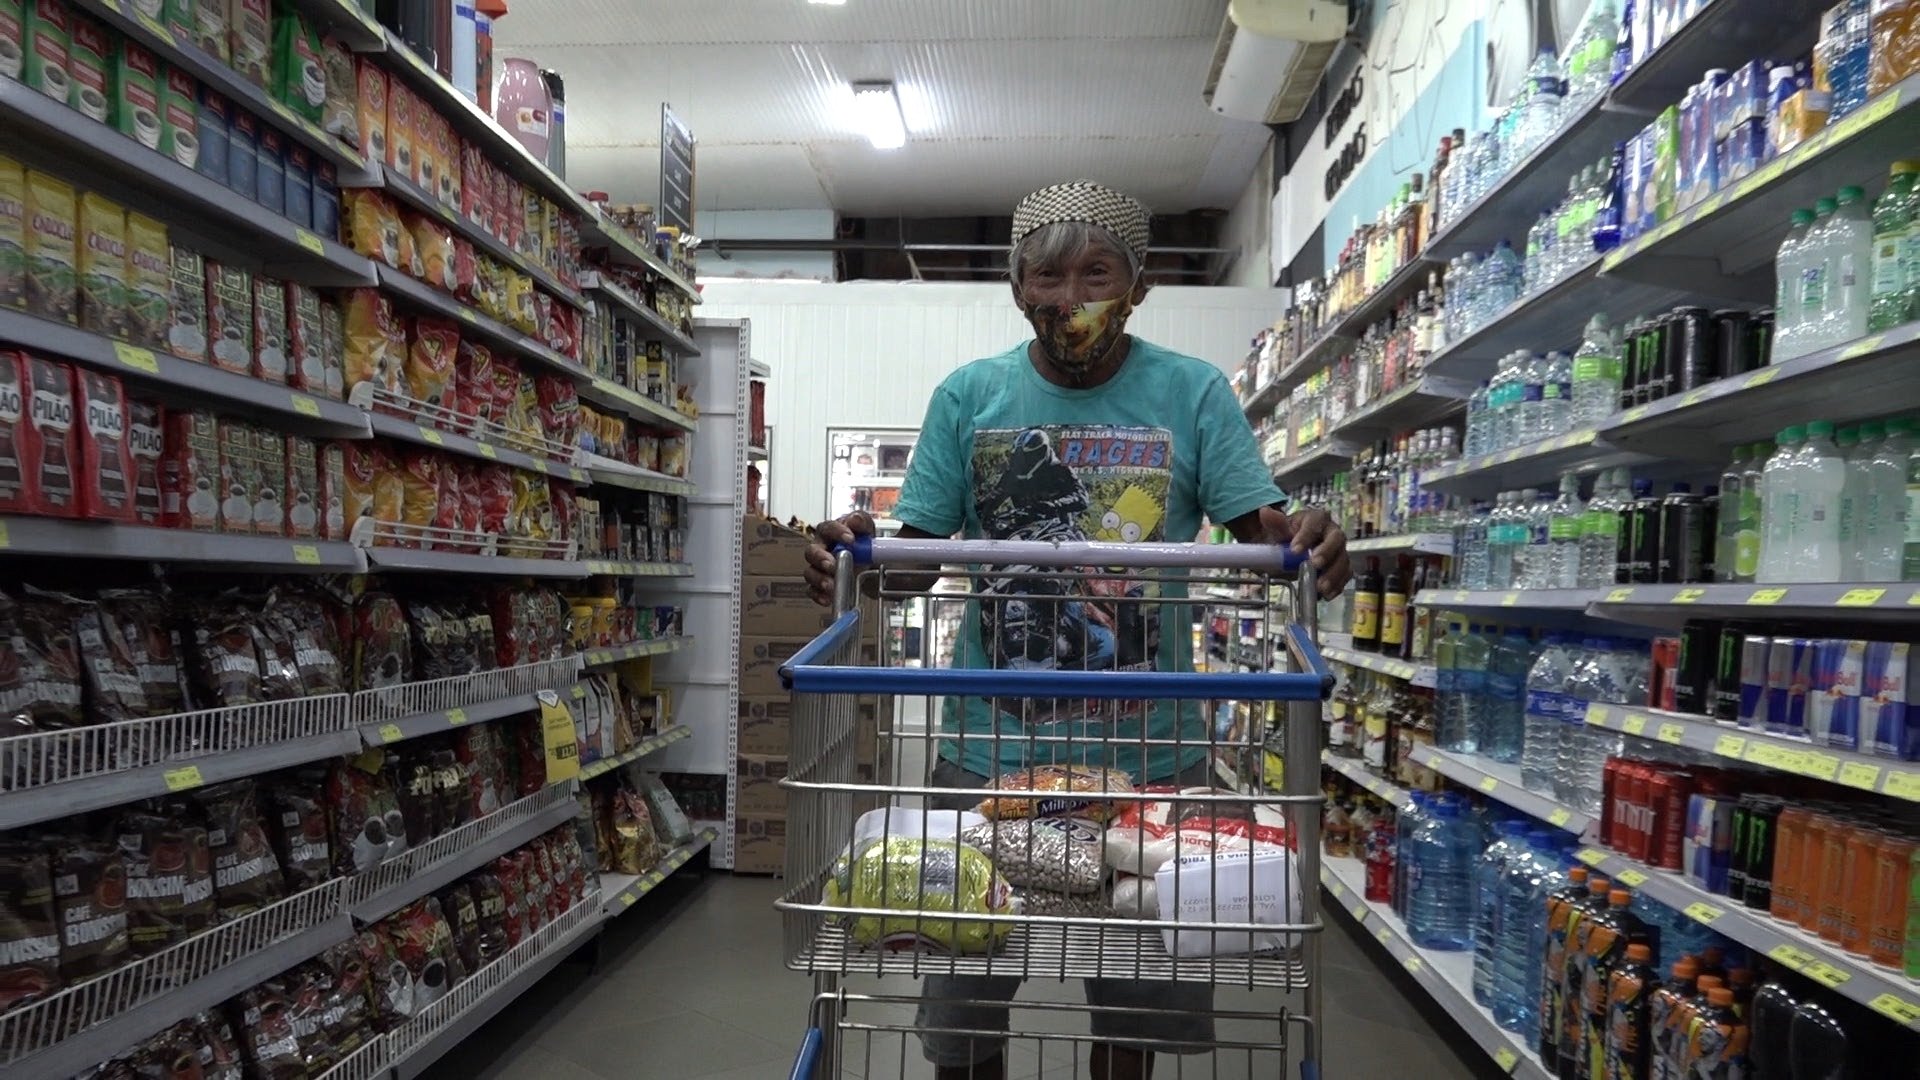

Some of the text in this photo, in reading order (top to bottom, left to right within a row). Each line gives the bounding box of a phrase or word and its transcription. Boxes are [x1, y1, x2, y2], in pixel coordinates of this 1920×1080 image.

[34, 397, 71, 424] PILÃO
[89, 406, 122, 431] PILÃO
[130, 429, 162, 452] PILÃO
[1061, 431, 1081, 439] FLAT
[1085, 431, 1112, 439] TRACK
[1063, 440, 1166, 466] RACES
